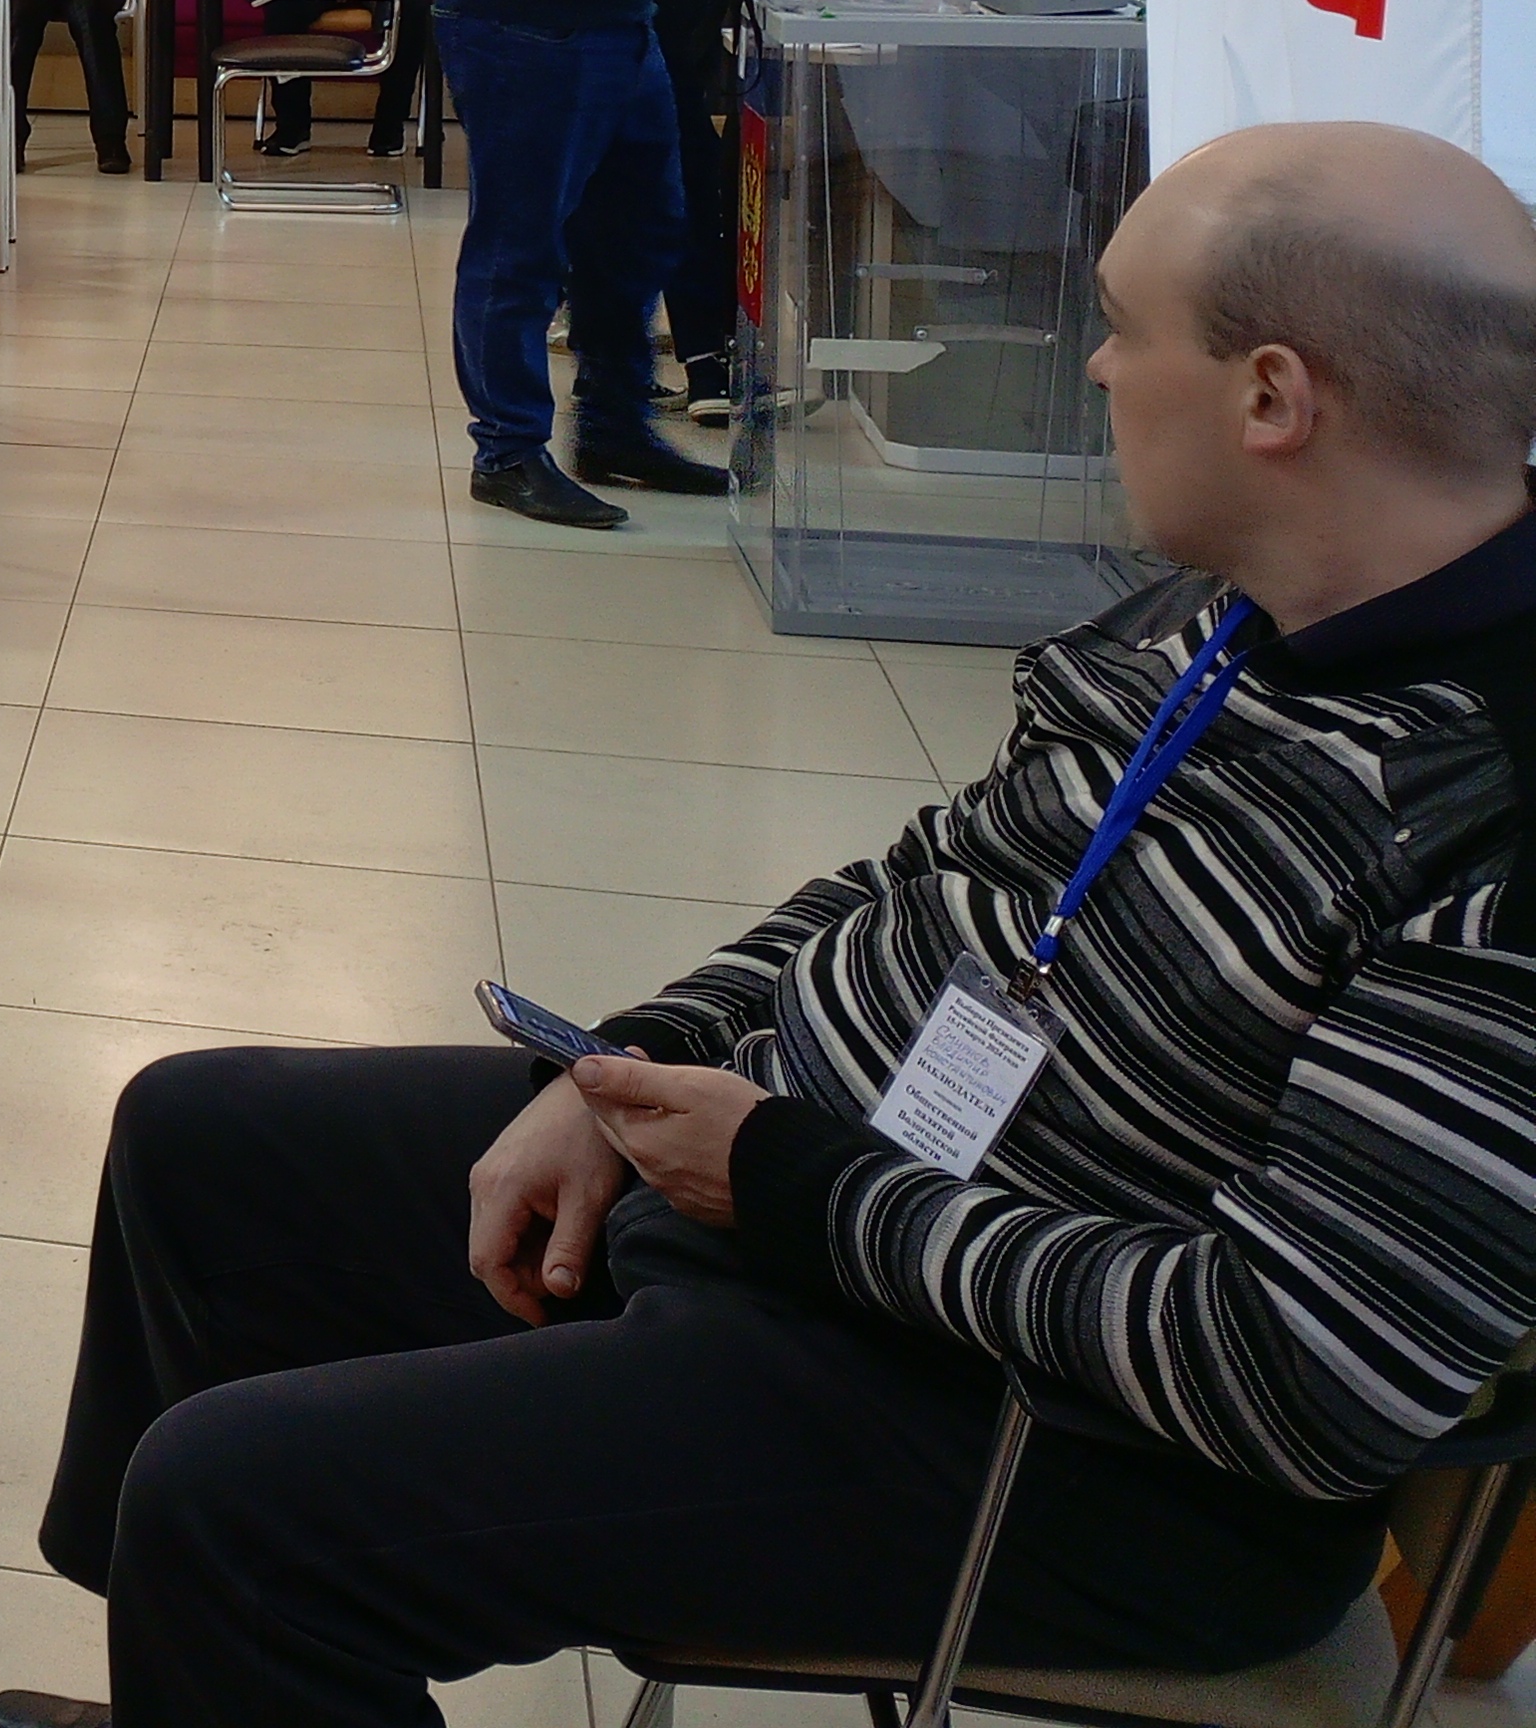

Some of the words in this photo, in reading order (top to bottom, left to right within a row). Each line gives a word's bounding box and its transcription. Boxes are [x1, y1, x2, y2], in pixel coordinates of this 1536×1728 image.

[945, 1016, 965, 1032] 15-17
[963, 1028, 986, 1047] марта
[986, 1042, 1004, 1057] 2024
[947, 1006, 989, 1036] Российской
[987, 1032, 1028, 1063] Федерации
[953, 998, 987, 1024] Выборы
[985, 1018, 1031, 1053] Президента
[902, 1084, 981, 1142] Общественной
[914, 1058, 999, 1118] НАБЛЮДАТЕЛЬ
[895, 1110, 962, 1159] Вологодской
[900, 1129, 943, 1161] области
[913, 1108, 956, 1141] палатой
